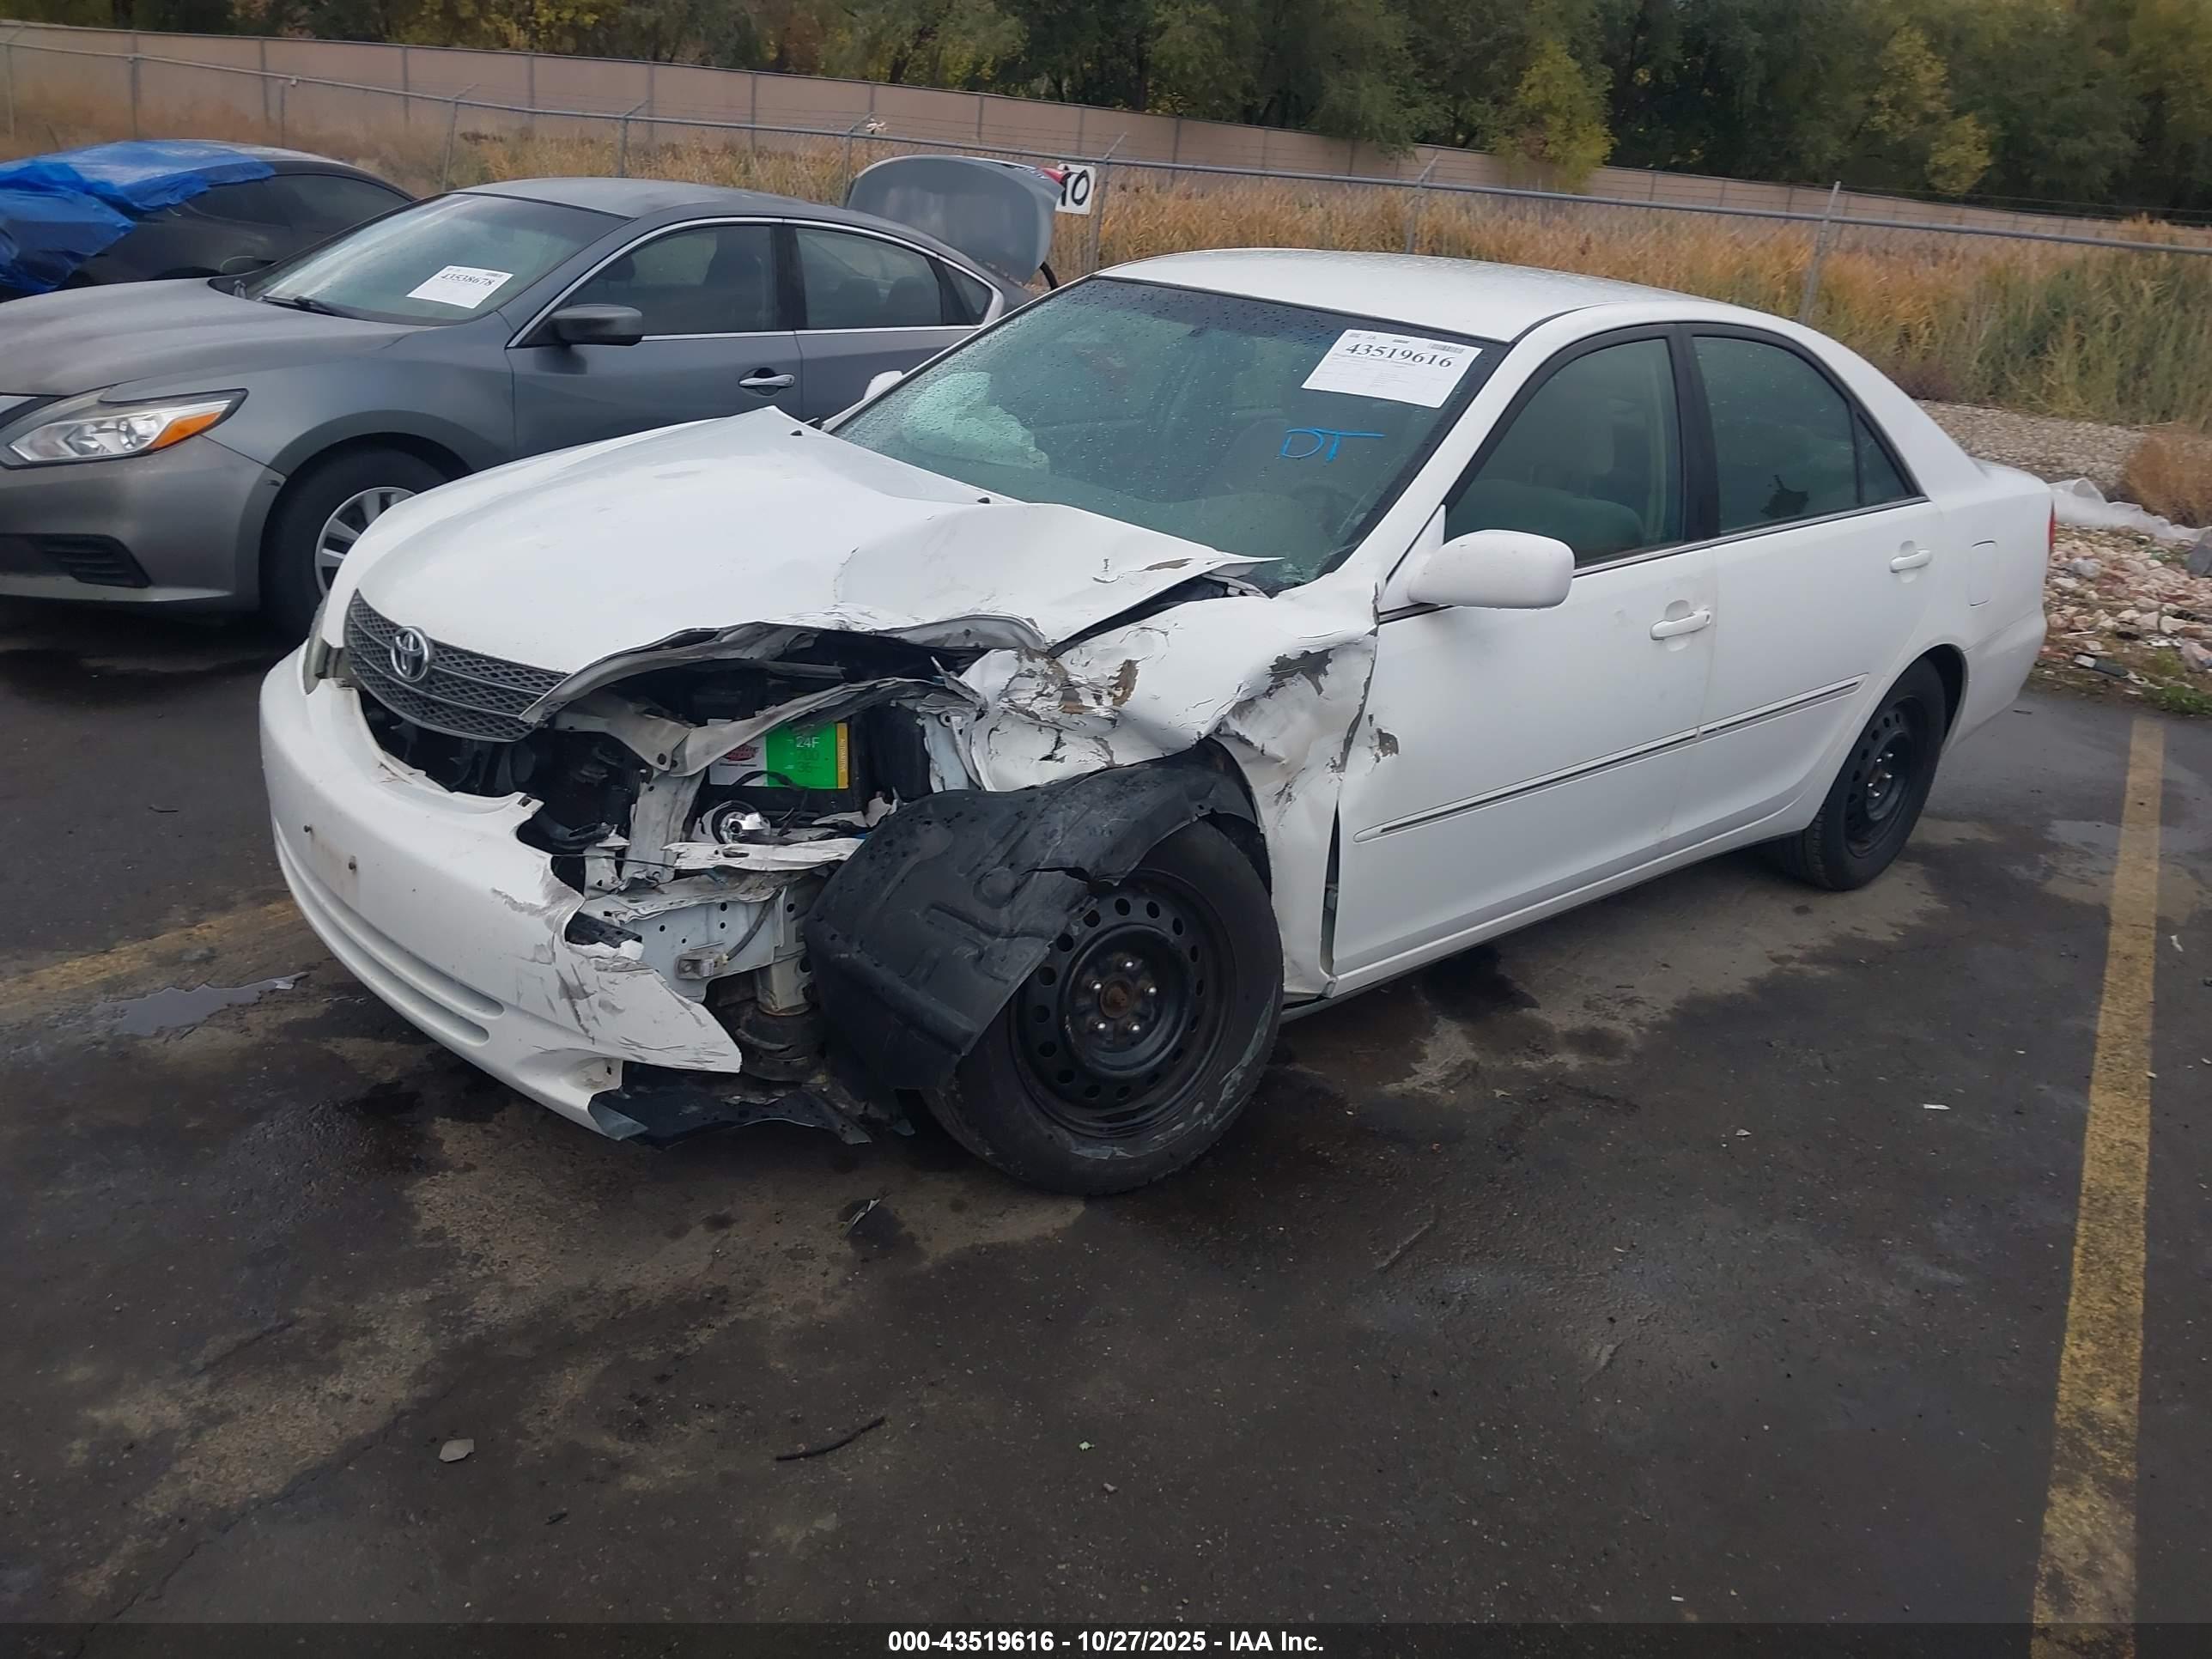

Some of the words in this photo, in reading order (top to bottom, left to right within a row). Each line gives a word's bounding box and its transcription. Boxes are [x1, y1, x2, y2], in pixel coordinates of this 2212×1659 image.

[1346, 343, 1455, 368] 43519616
[1280, 428, 1385, 462] DT
[796, 736, 820, 749] 24F
